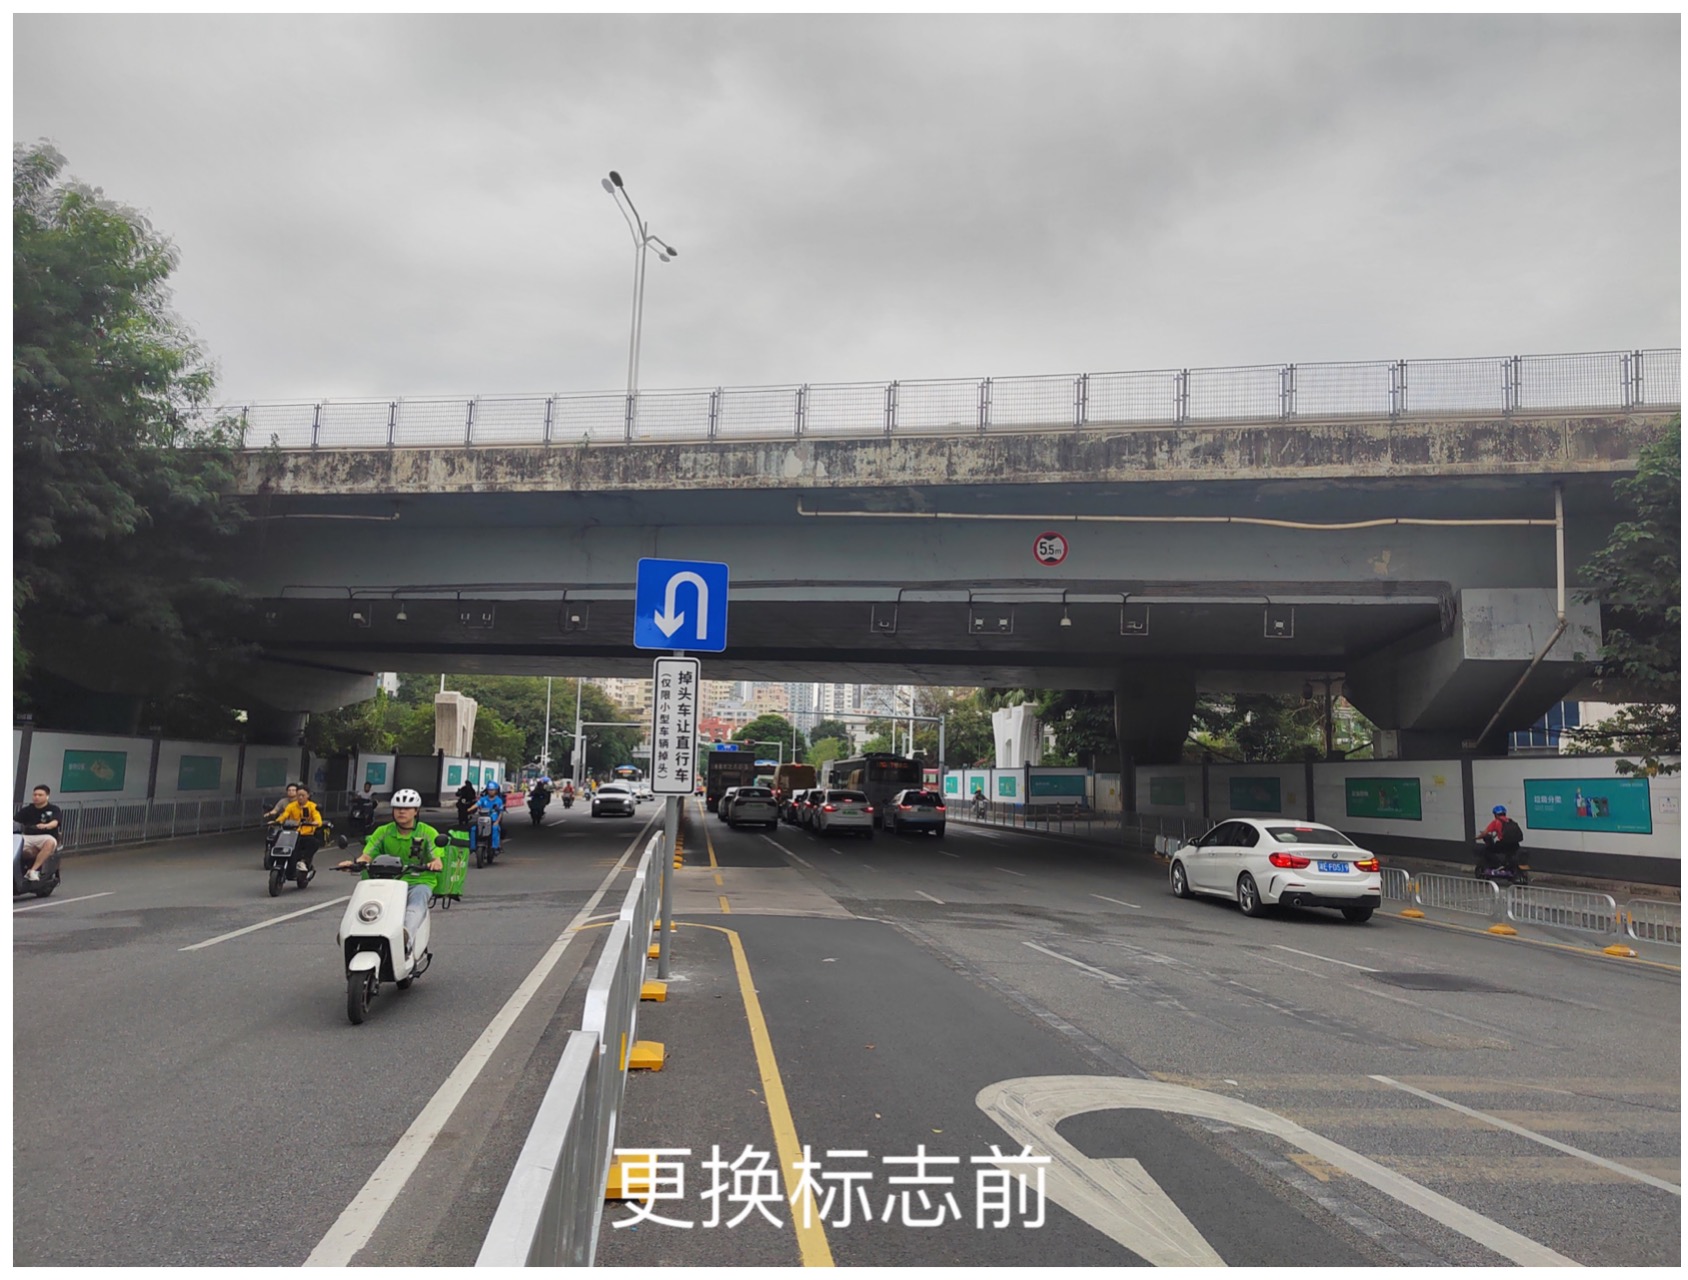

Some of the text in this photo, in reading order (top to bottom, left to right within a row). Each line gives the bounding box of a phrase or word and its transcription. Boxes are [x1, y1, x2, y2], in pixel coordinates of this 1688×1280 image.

[657, 672, 672, 780] (仅限小型车辆掉头)
[675, 670, 693, 783] 掉头车让直行车
